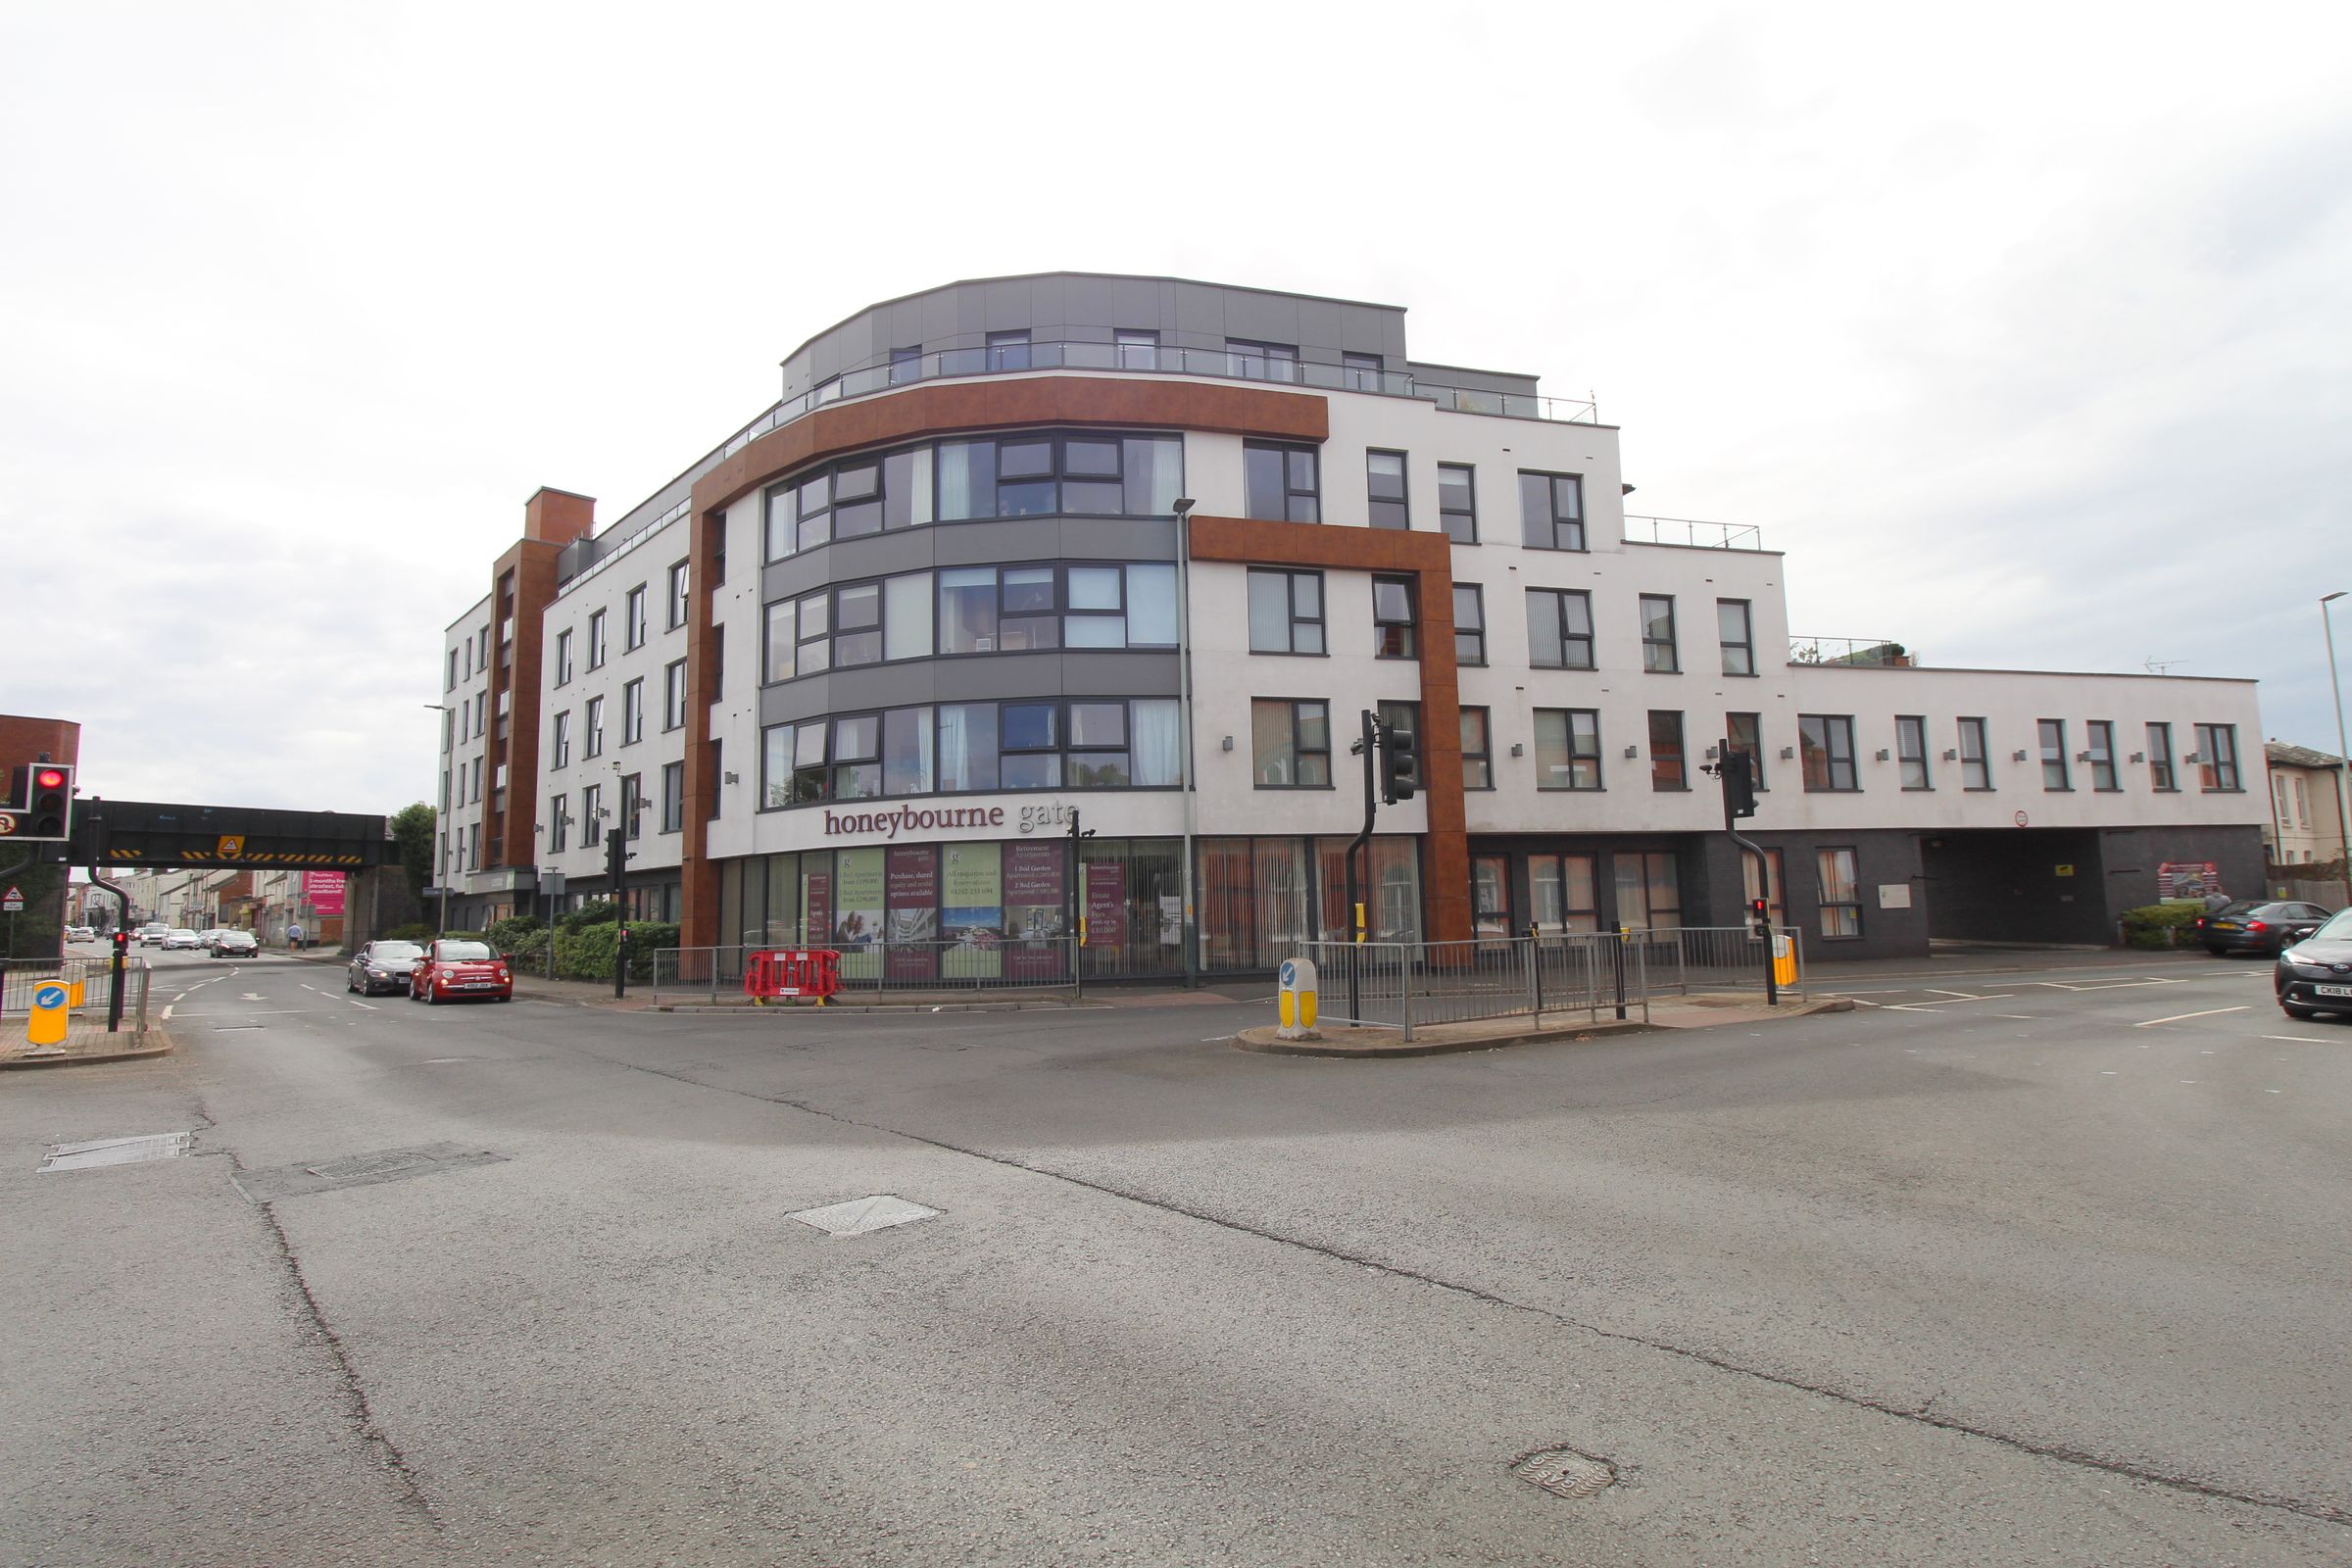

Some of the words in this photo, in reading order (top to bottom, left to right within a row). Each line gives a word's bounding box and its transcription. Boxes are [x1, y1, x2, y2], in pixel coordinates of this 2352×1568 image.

[824, 805, 1004, 838] honeybourne
[1019, 801, 1077, 834] gate
[2321, 986, 2341, 995] CK18
